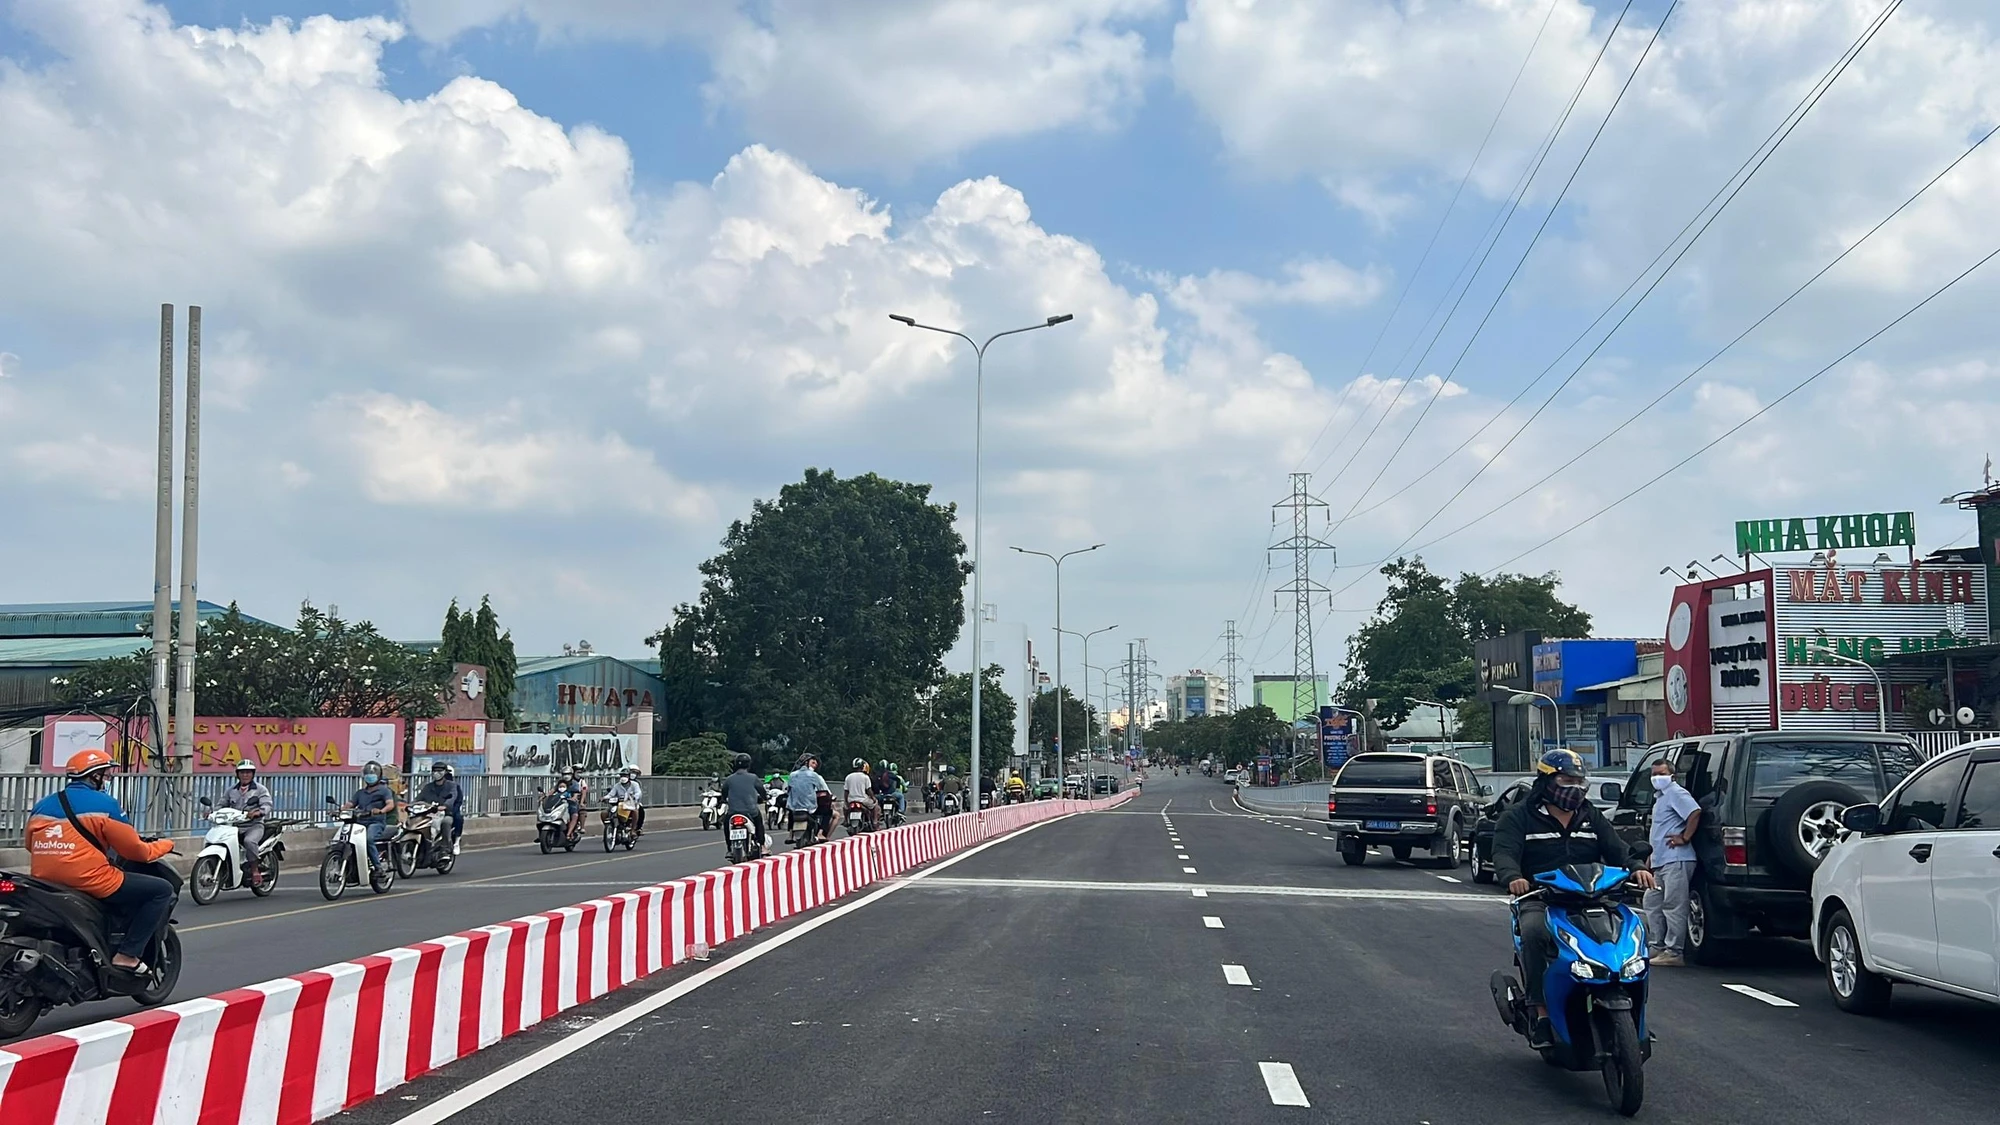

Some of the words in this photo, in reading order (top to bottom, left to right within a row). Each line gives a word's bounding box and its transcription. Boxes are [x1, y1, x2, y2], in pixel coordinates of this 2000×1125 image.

[1735, 517, 1809, 554] NHA
[1817, 511, 1916, 551] KHOA
[1880, 558, 1974, 604] KÍNH
[557, 682, 655, 707] HWATA
[216, 723, 243, 735] TY
[253, 740, 344, 767] VINA
[33, 840, 76, 851] AhaMove
